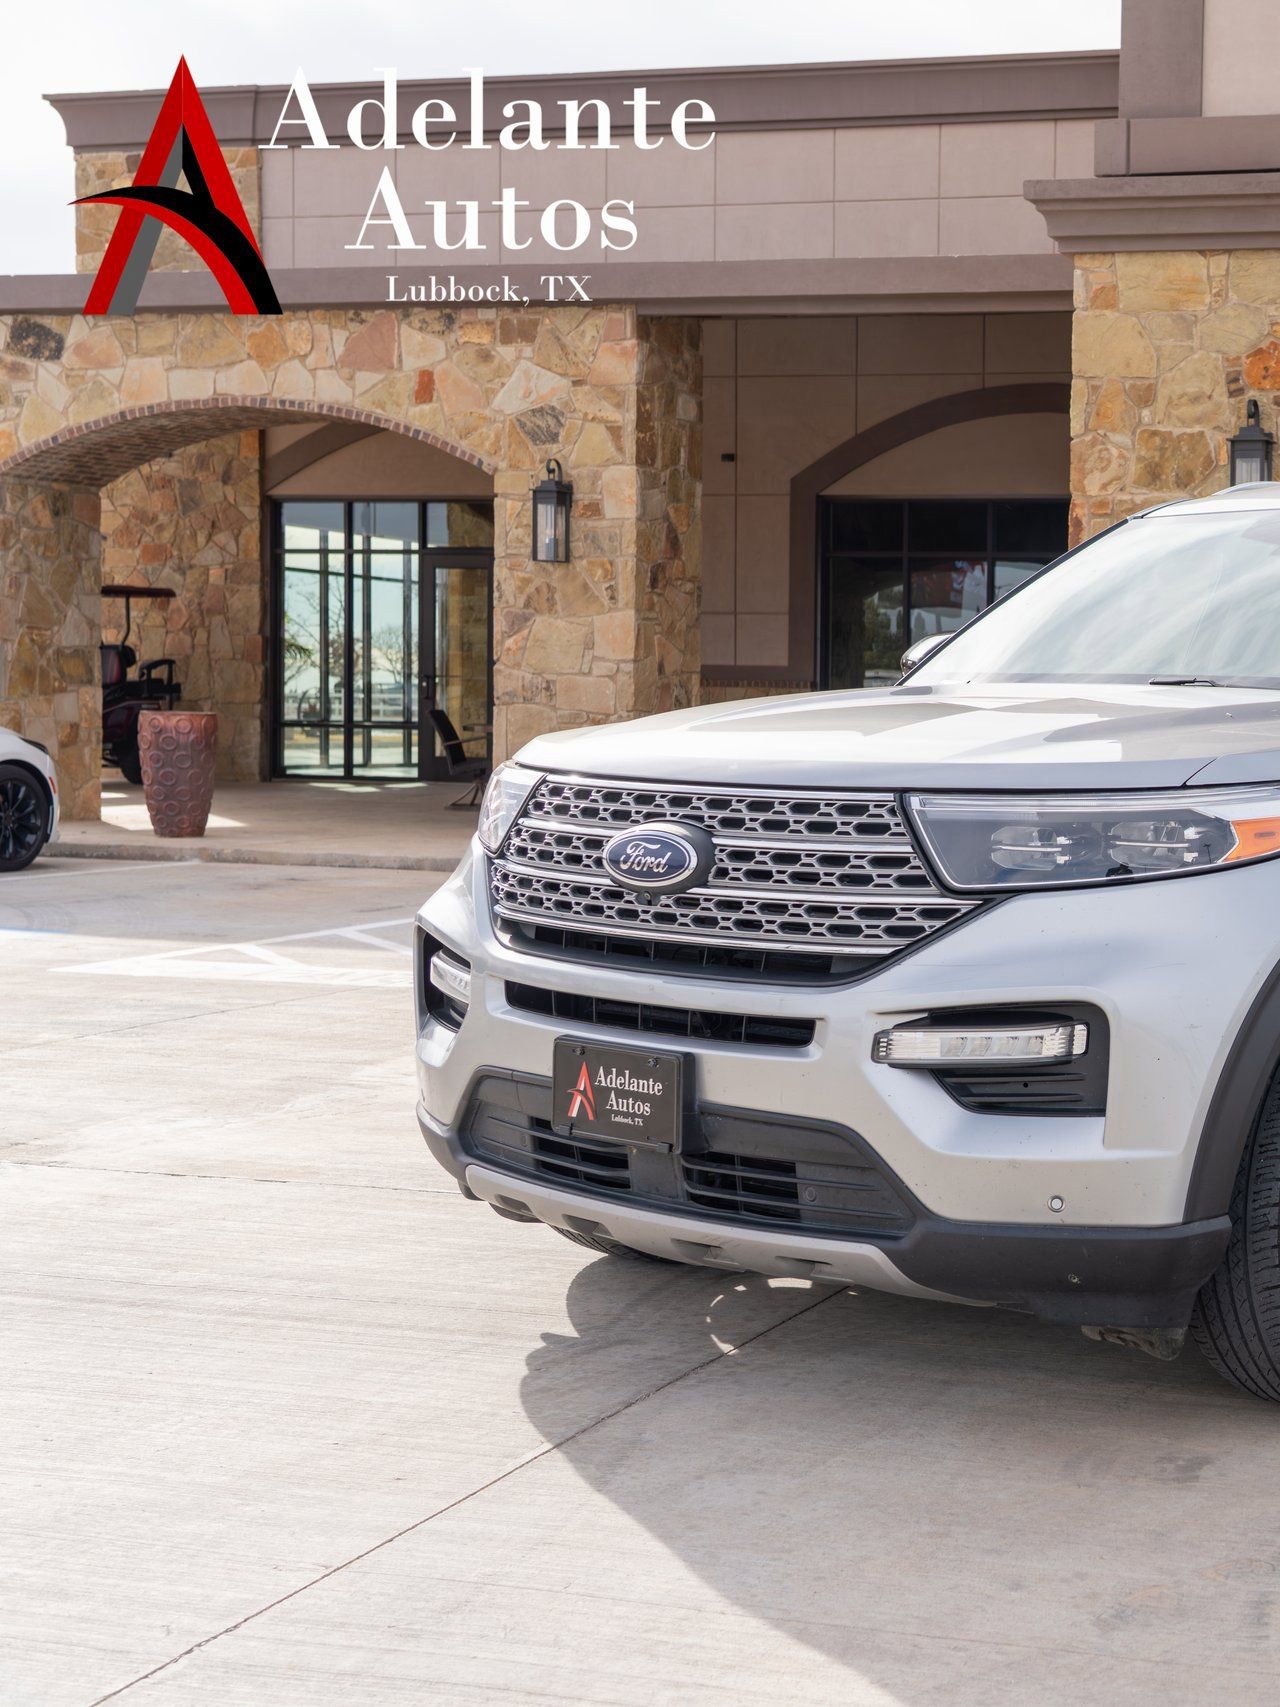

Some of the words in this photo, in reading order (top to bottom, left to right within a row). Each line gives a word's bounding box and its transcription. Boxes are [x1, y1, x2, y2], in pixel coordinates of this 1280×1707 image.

[620, 840, 672, 874] Ford
[594, 1065, 663, 1096] Adelante
[605, 1090, 652, 1116] Autos
